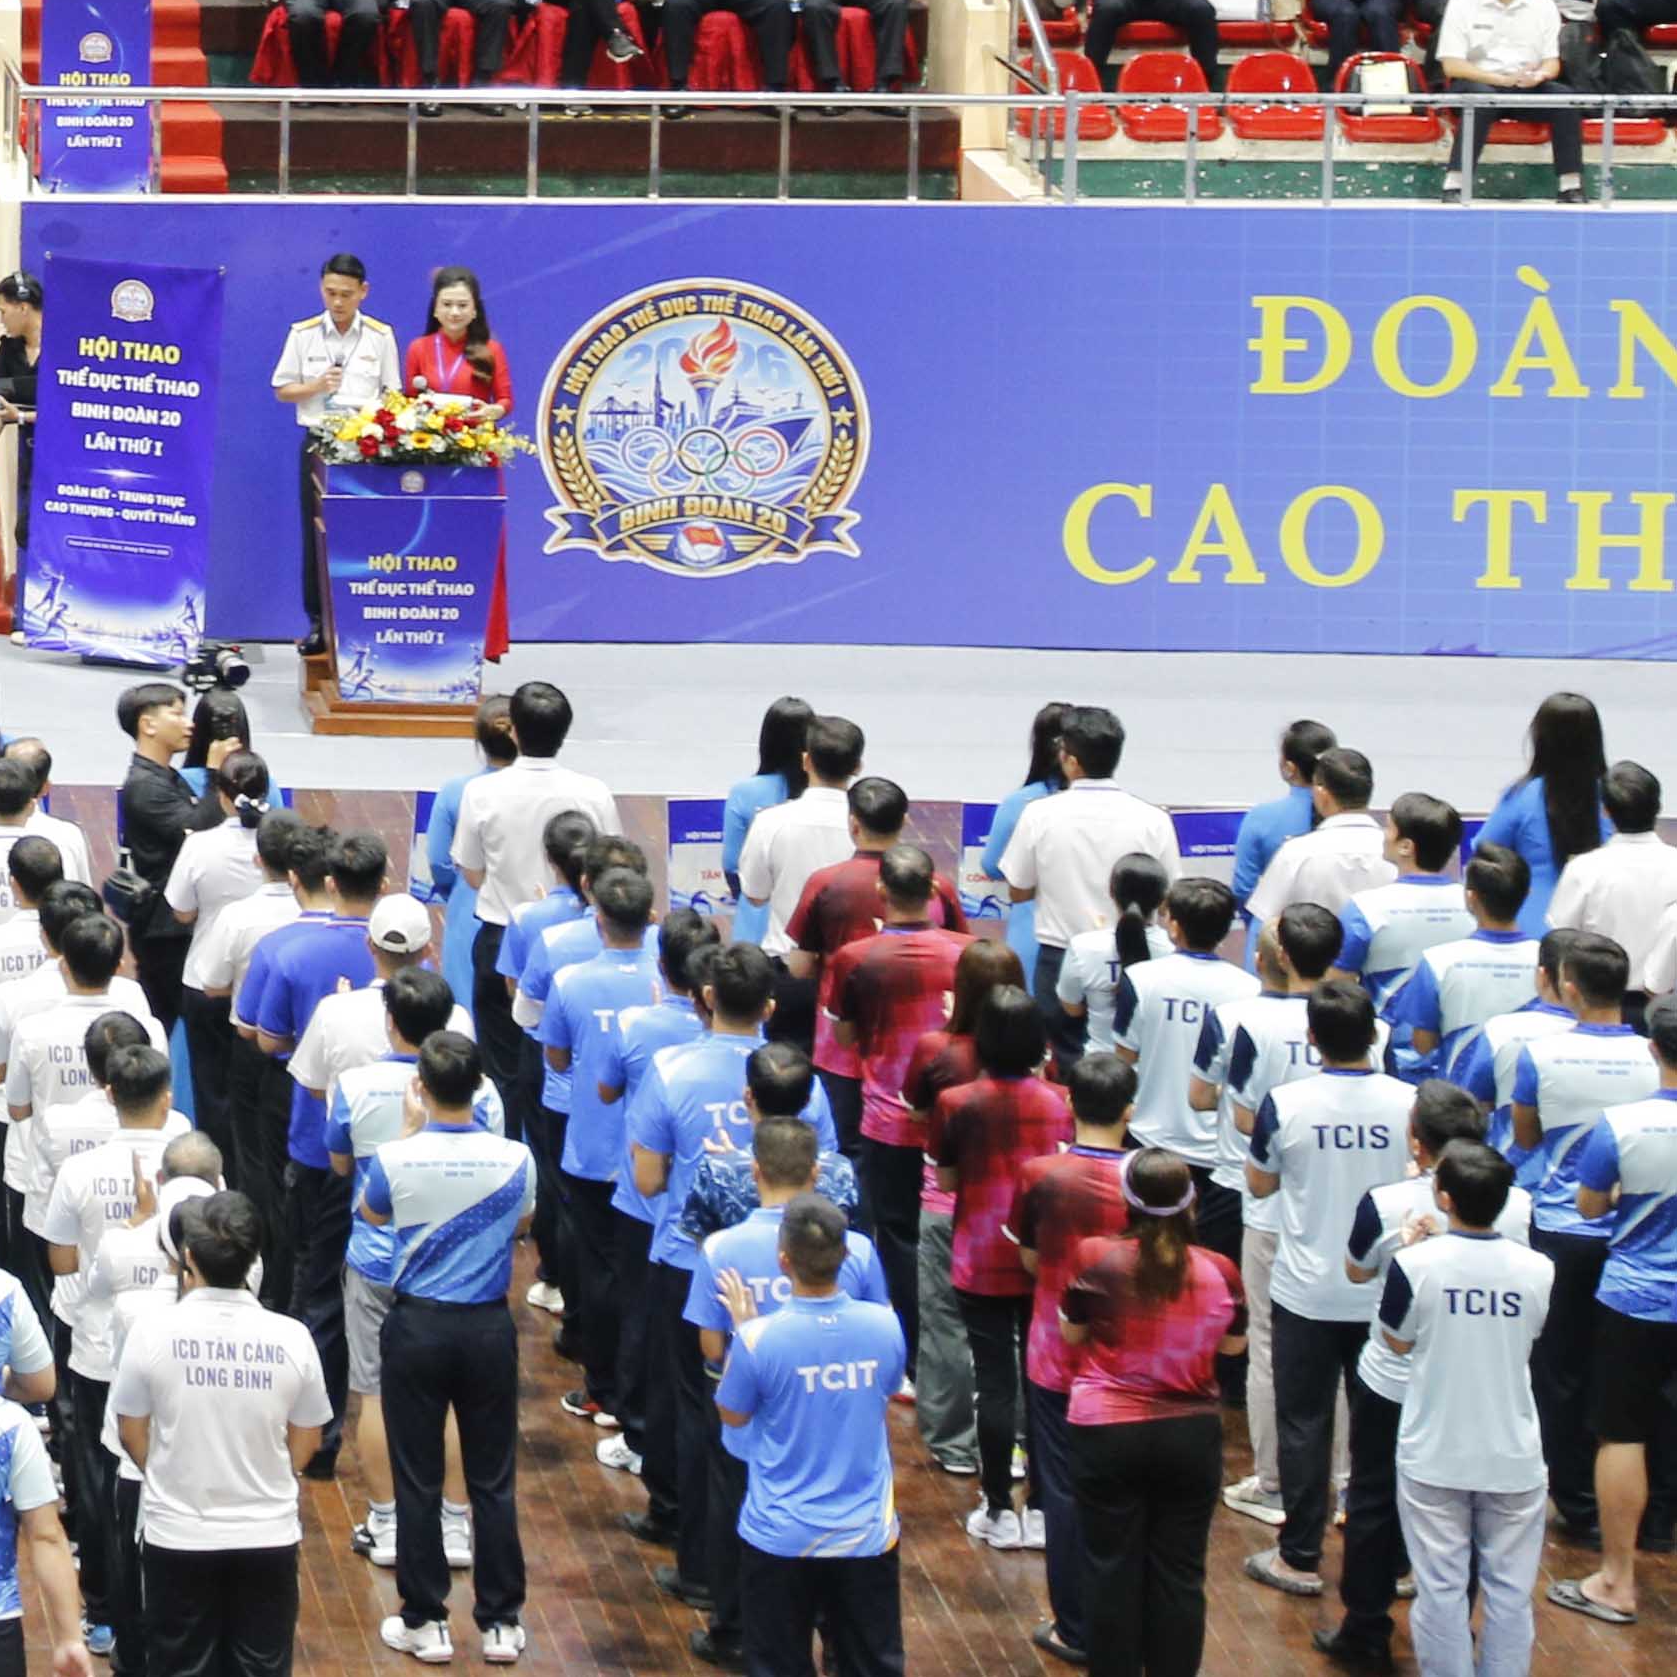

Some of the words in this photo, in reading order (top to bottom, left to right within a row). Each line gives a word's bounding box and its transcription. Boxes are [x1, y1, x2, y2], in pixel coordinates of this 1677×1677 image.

[60, 73, 87, 87] HỘI
[88, 73, 131, 86] THAO
[117, 115, 134, 127] 20
[590, 325, 627, 360] THAO
[626, 299, 661, 332] THỂ
[660, 295, 698, 318] DỤC
[701, 291, 738, 314] THỂ
[739, 298, 788, 331] THAO
[1248, 265, 1677, 399] ĐOÀN
[79, 337, 118, 362] HỘI
[121, 341, 181, 365] THAO
[56, 366, 91, 389] THỂ
[89, 372, 123, 393] DỤC
[123, 371, 157, 394] THỂ
[155, 380, 200, 398] THAO
[71, 402, 109, 421] BINH
[112, 404, 160, 425] ĐOÀN
[159, 409, 181, 427] 20
[118, 434, 154, 455] THỨ
[154, 440, 163, 457] I
[619, 497, 678, 531] BINH
[683, 493, 752, 523] ĐOÀN
[756, 506, 788, 534] 20
[1062, 482, 1267, 587] CAO
[368, 555, 402, 573] HỘI
[406, 555, 457, 572] THAO
[349, 578, 379, 595] THỂ
[377, 582, 408, 597] DỤC
[408, 579, 437, 595] THỂ
[436, 583, 475, 596] THAO
[363, 606, 397, 620] BINH
[399, 605, 440, 620] ĐOÀN
[441, 607, 459, 620] 20
[2, 957, 23, 972] ICD
[48, 1045, 72, 1063] ICD
[1312, 1124, 1390, 1150] TCIS
[93, 1179, 117, 1195] ICD
[133, 1267, 159, 1284] ICD
[1443, 1289, 1522, 1317] TCIS
[172, 1338, 200, 1360] ICD
[205, 1336, 237, 1362] TÂN
[243, 1338, 285, 1364] CẢNG
[186, 1366, 228, 1387] LONG
[234, 1365, 272, 1390] BÌNH
[796, 1360, 878, 1394] TCIT
